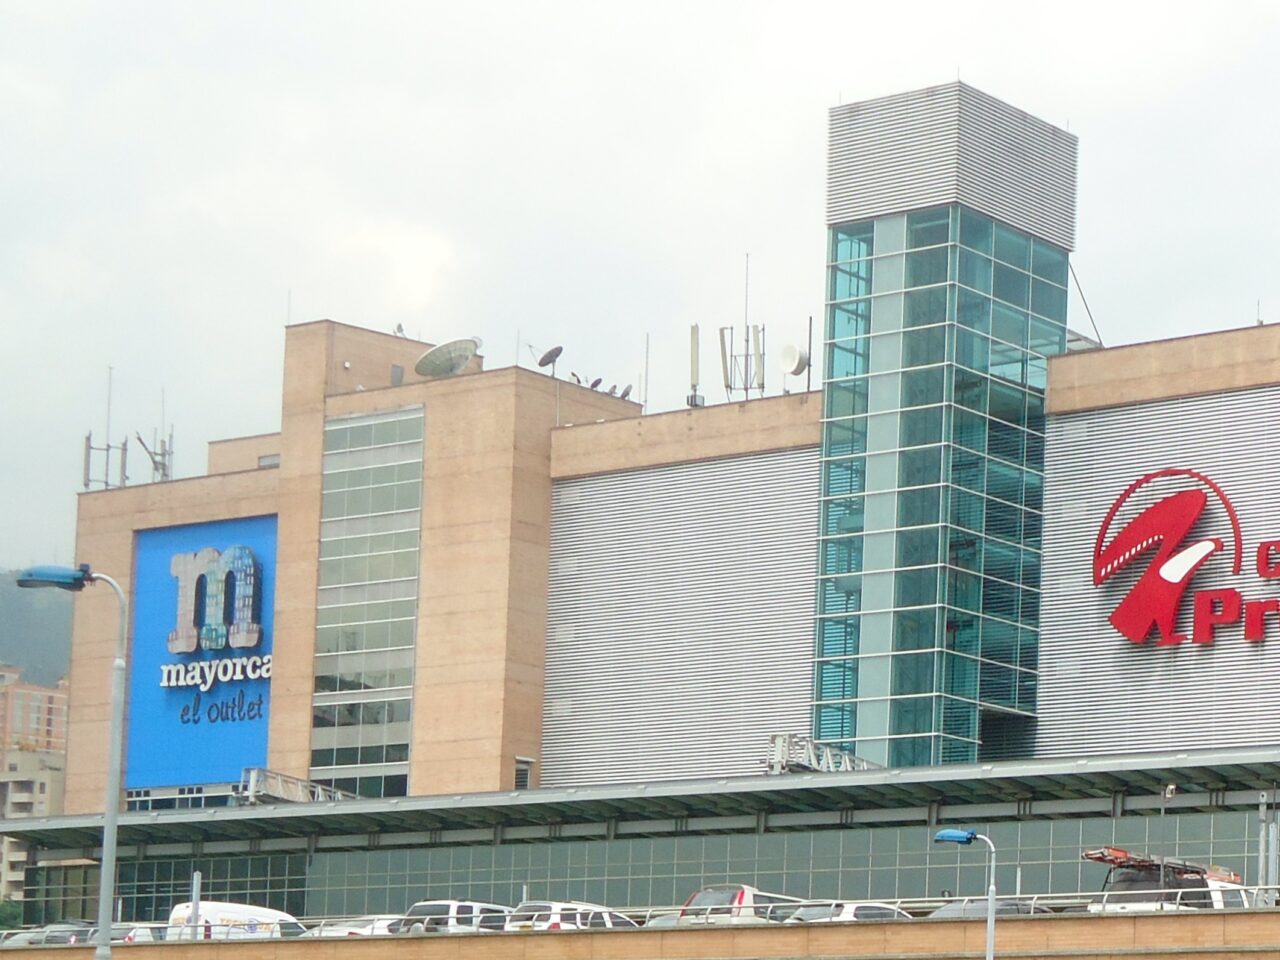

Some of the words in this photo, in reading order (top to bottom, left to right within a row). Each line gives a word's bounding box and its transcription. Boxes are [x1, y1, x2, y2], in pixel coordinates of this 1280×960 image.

[160, 655, 272, 692] mayorca
[181, 692, 200, 725] el
[207, 689, 263, 725] outlet
